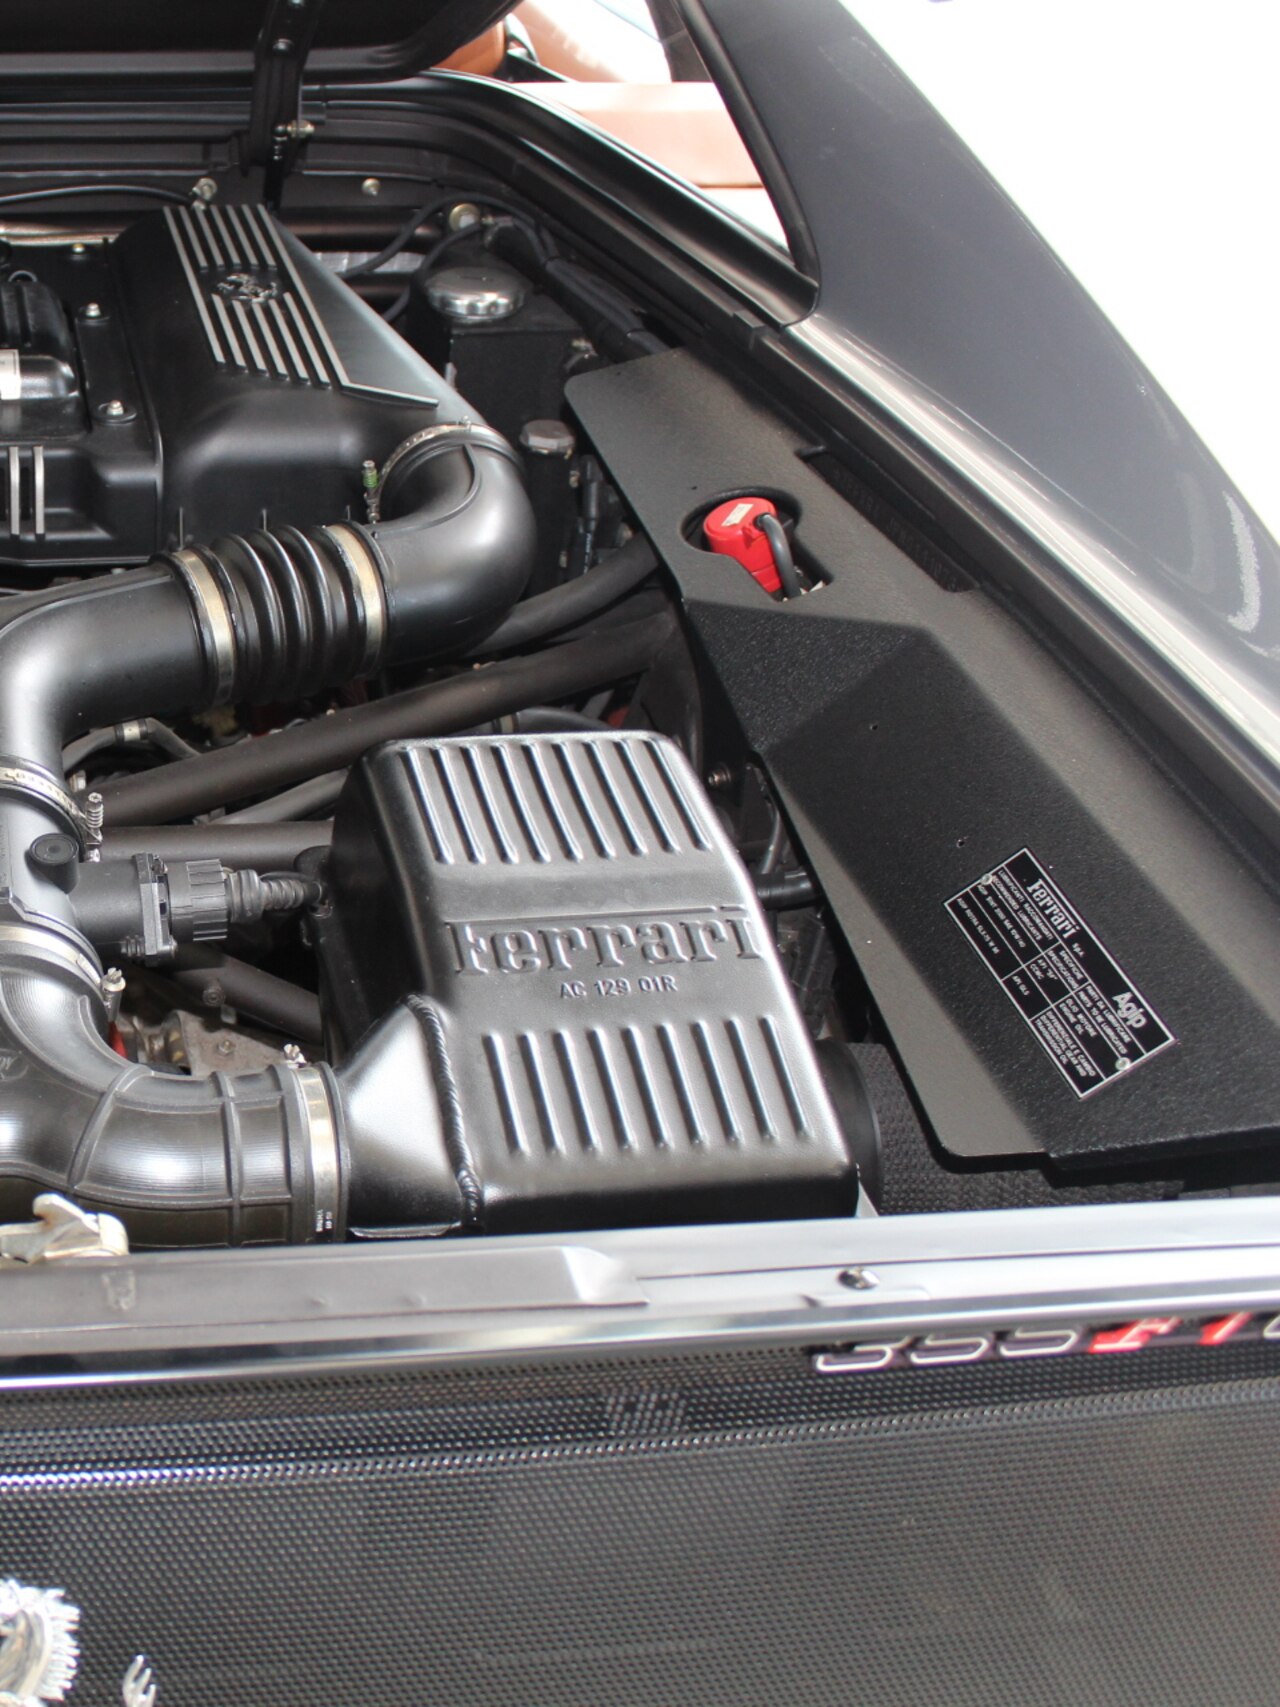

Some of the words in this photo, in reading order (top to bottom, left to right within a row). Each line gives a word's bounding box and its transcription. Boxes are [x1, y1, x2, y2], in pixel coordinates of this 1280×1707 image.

[1026, 878, 1080, 939] Ferrari
[443, 904, 762, 975] Ferrari
[594, 979, 631, 998] 129
[1112, 991, 1147, 1028] Agip
